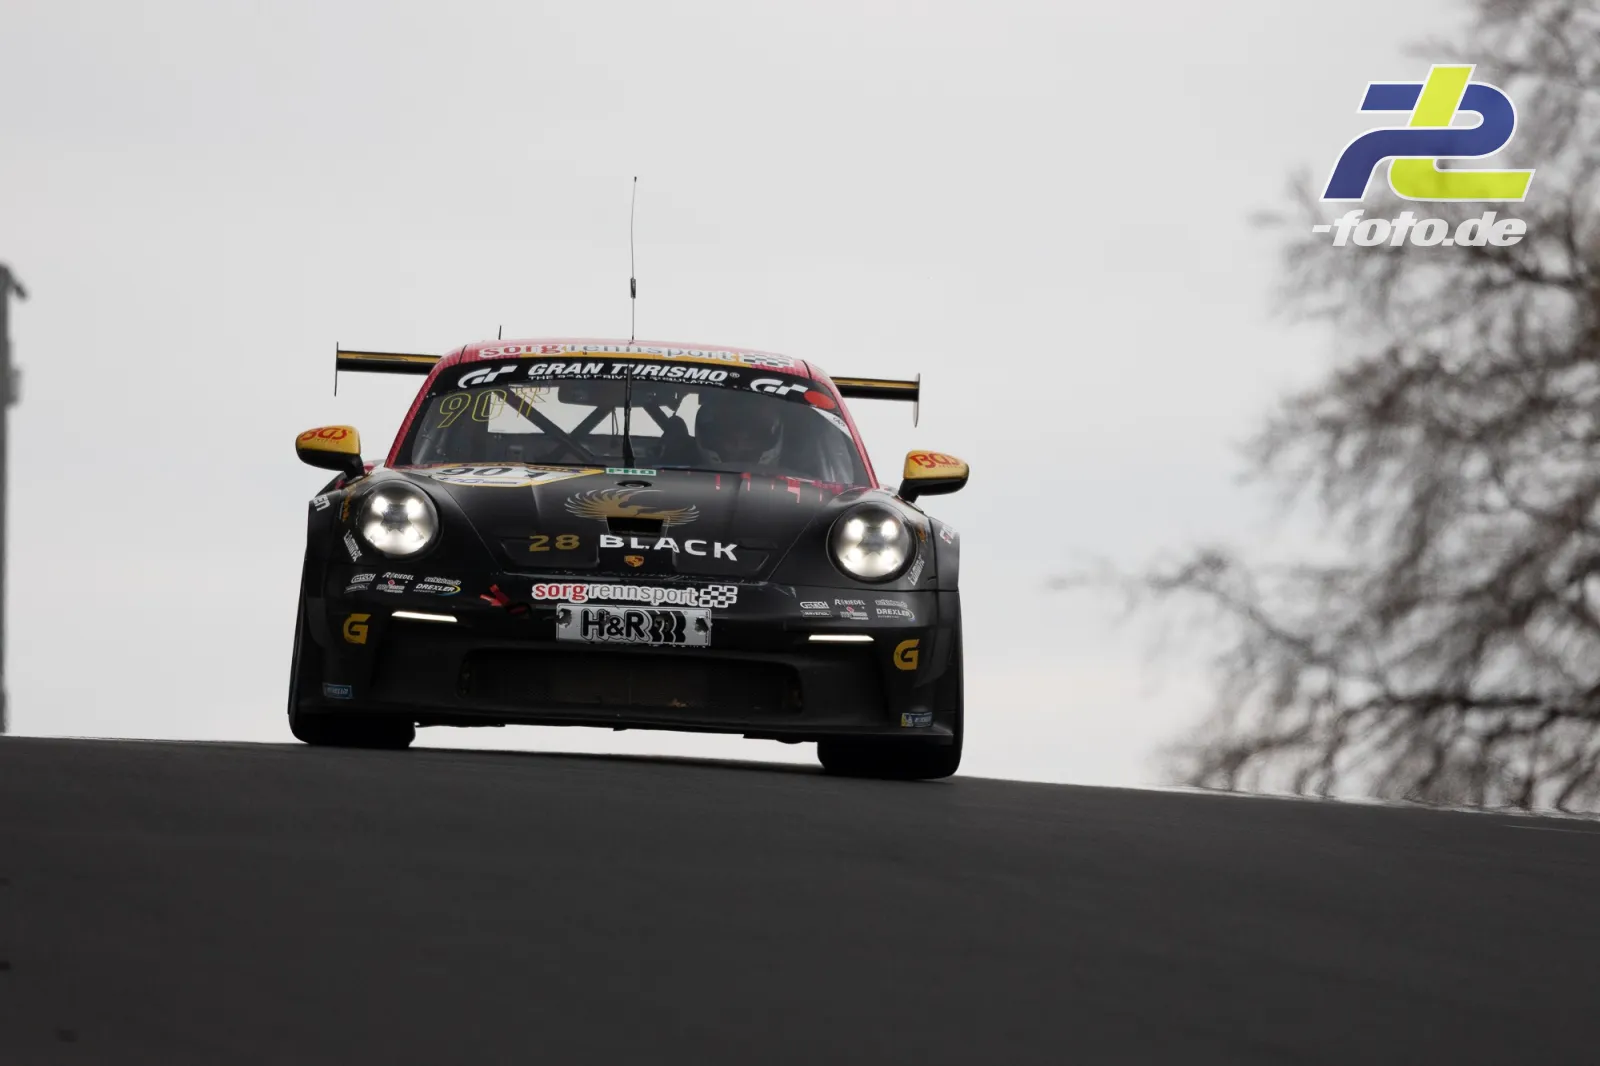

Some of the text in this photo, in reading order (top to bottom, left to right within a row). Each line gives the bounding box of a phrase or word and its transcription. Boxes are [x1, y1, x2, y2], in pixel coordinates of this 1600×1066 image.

[478, 344, 738, 362] sorgrennsport
[527, 363, 604, 375] GRAN
[529, 535, 580, 552] 28
[600, 535, 738, 561] BLACK
[415, 584, 456, 592] DREXLER
[532, 584, 698, 606] sorgrennsport
[876, 608, 911, 617] DREXLER
[343, 613, 371, 644] G
[581, 608, 652, 641] H&R
[893, 639, 920, 671] G
